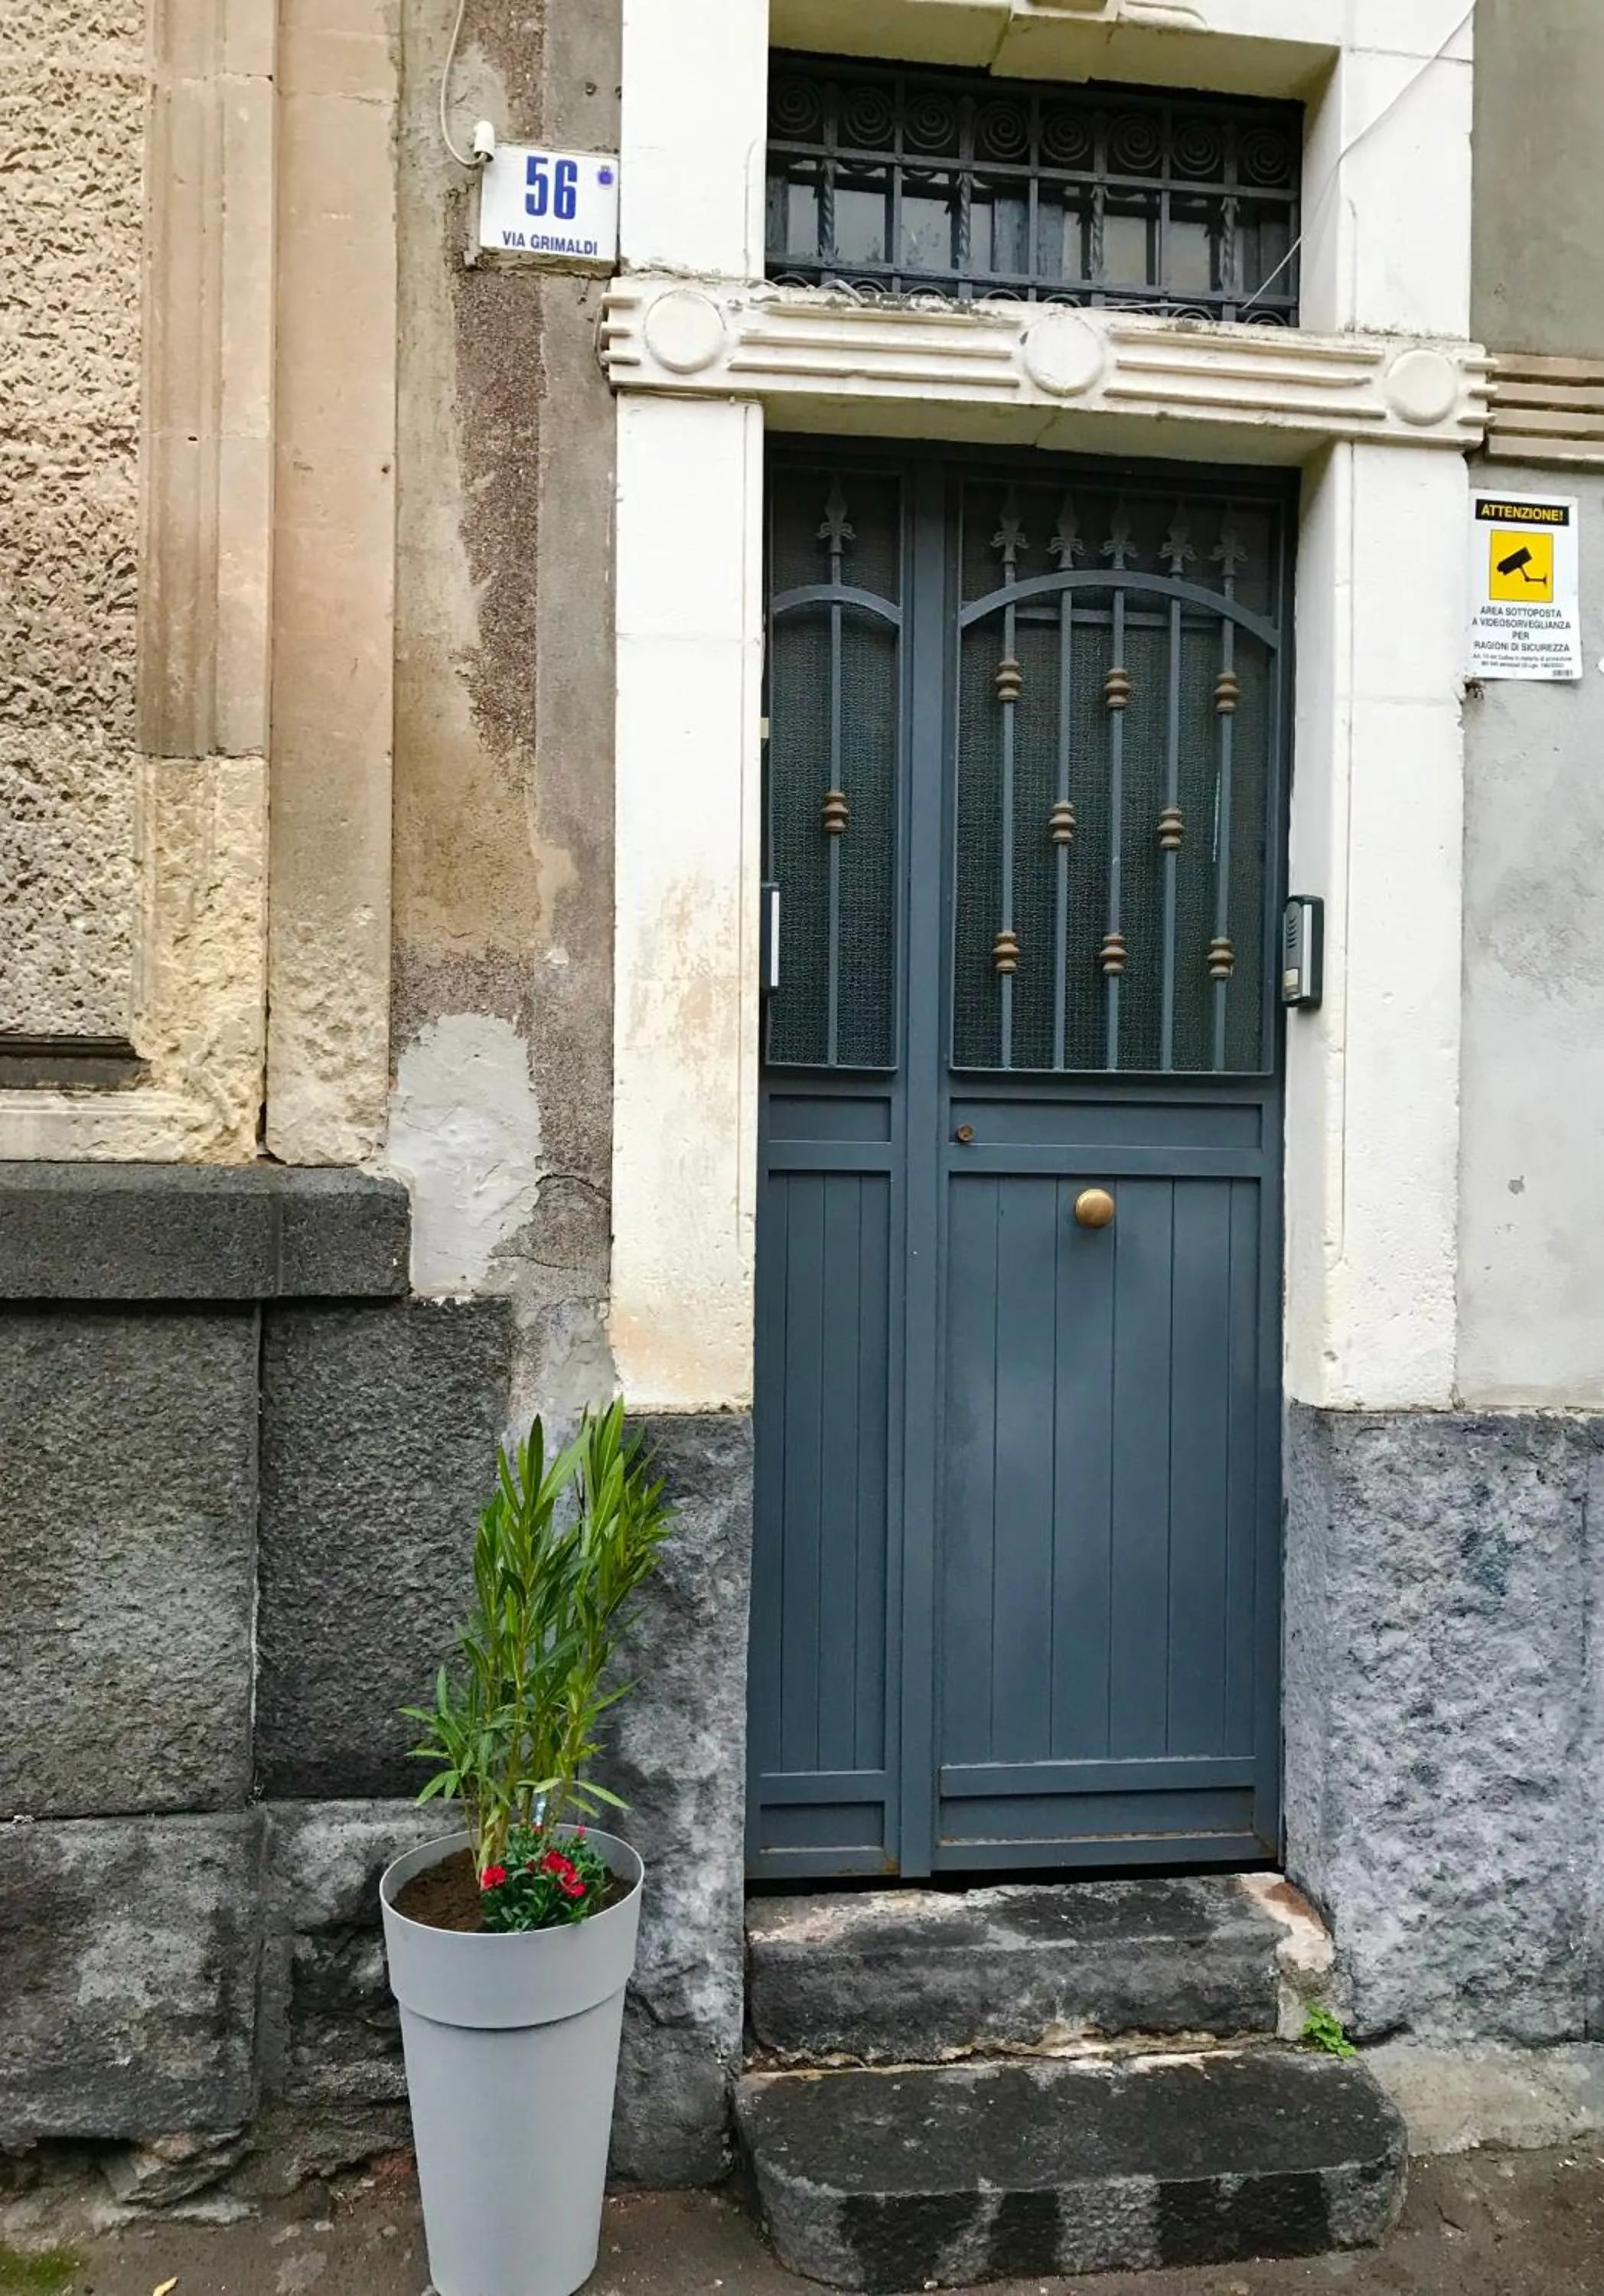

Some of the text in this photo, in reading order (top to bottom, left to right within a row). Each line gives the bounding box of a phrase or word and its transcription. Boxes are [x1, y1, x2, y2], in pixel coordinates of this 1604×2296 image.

[525, 155, 578, 220] 56
[502, 230, 598, 256] VIA GRIMALDI
[1481, 504, 1563, 522] ATTENZIONE!
[1480, 605, 1562, 618] AREA SOTTOPOSTA
[1480, 618, 1571, 629] VIDEOSORVEGLIANZA
[1512, 631, 1530, 640] PER
[1474, 641, 1570, 652] RAGIONI DI SICUREZZA
